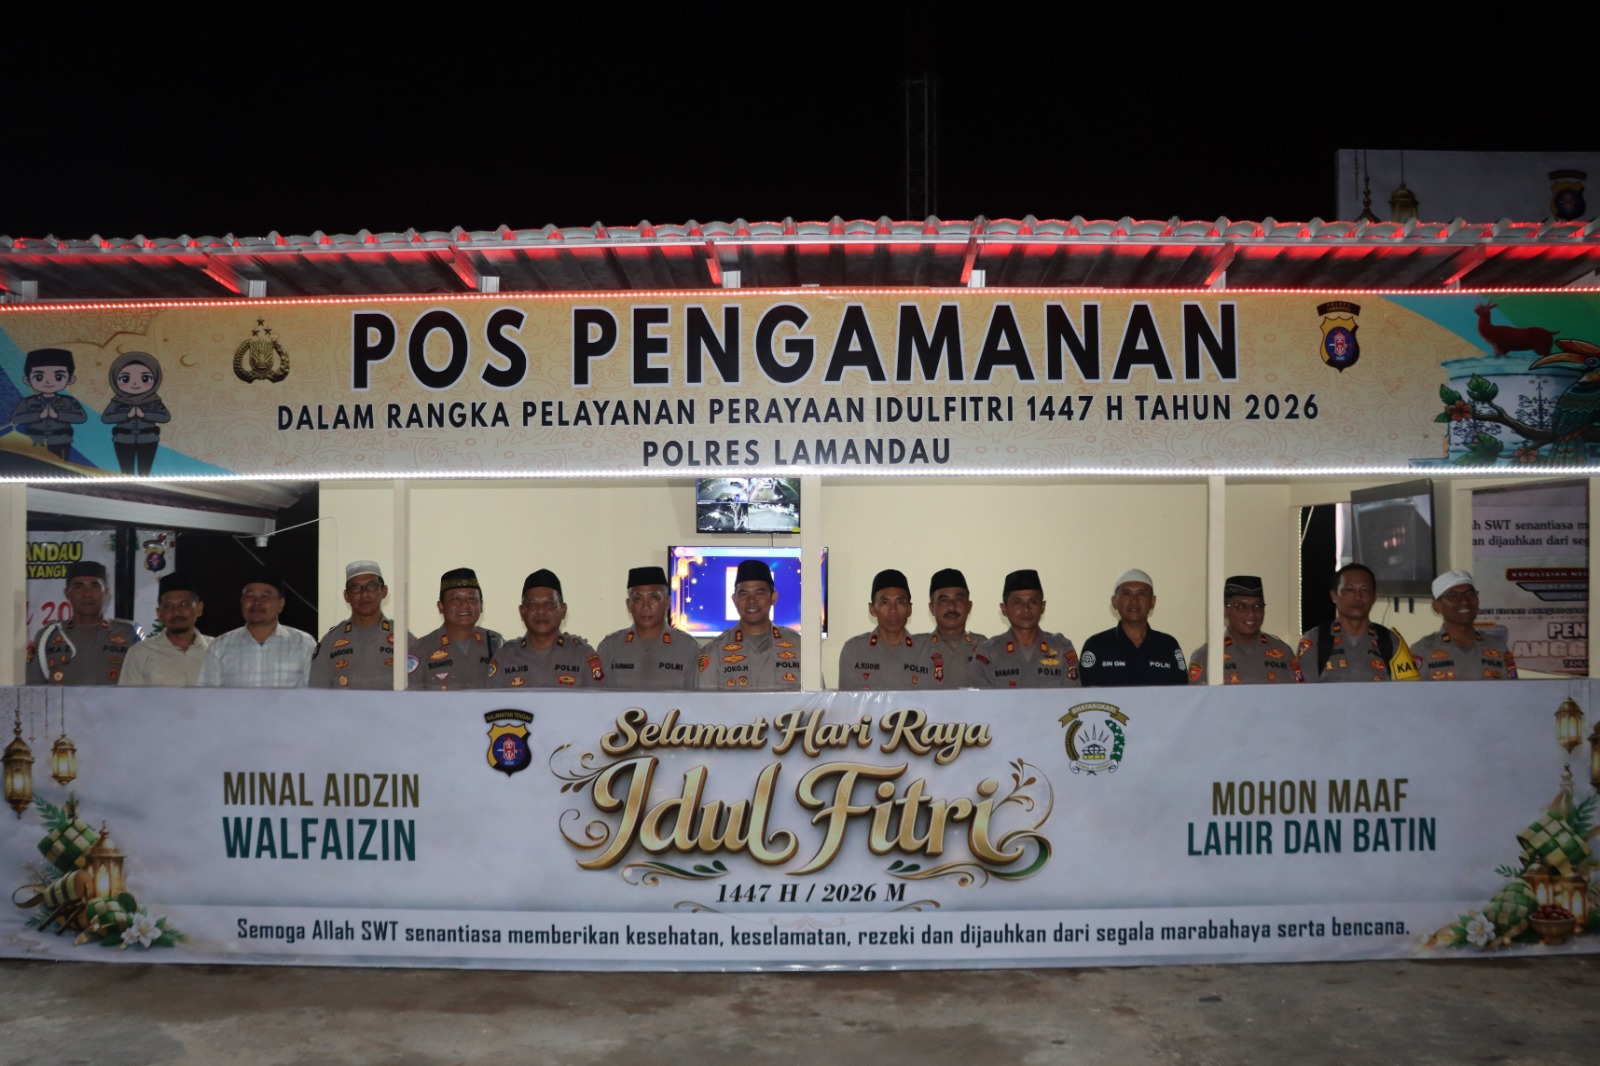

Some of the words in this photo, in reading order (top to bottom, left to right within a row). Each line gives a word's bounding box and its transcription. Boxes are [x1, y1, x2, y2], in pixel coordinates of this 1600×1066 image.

[354, 309, 527, 388] POS
[574, 304, 1237, 385] PENGAMANAN
[278, 404, 374, 430] DALAM
[388, 402, 509, 428] RANGKA
[523, 399, 695, 426] PELAYANAN
[710, 397, 865, 424] PERAYAAN
[876, 396, 1013, 422] IDULFITRI
[1027, 396, 1093, 421] 1447
[1107, 396, 1122, 420] H
[1135, 395, 1231, 420] TAHUN
[1245, 394, 1319, 419] 2026
[643, 440, 760, 466] POLRES
[775, 438, 950, 465] LAMANDAU
[1485, 520, 1511, 530] SWT
[1515, 520, 1573, 530] senantiasa
[1488, 535, 1543, 547] dijauhkan
[1546, 535, 1569, 546] dari
[554, 663, 580, 673] POLRI
[658, 662, 684, 672] POLRI
[775, 661, 800, 669] POLRI
[903, 663, 929, 675] POLRI
[1037, 667, 1062, 677] POLRI
[1149, 661, 1171, 669] POLRI
[1263, 660, 1288, 670] POLRI
[1071, 703, 1117, 715] BHAYANGKARI
[600, 707, 767, 756] Selamat
[773, 709, 872, 757] Hari
[879, 708, 993, 765] Raya
[224, 772, 314, 806] MINAL
[323, 773, 420, 808] AIDZIN
[1213, 780, 1317, 816] MOHON
[1326, 778, 1409, 813] MAAF
[575, 755, 799, 871] Idul
[785, 761, 1025, 877] Fitri
[222, 817, 417, 861] WALFAIZIN
[1188, 821, 1273, 856] LAHIR
[1285, 819, 1342, 854] DAN
[1354, 817, 1436, 852] BATIN
[716, 883, 772, 903] 1447
[778, 883, 799, 903] H
[822, 883, 877, 903] 2026
[885, 883, 907, 903] M
[238, 918, 305, 943] Semoga
[312, 919, 355, 941] Allah
[362, 921, 399, 942] SWT
[405, 925, 501, 944] senantiasa
[508, 924, 619, 946] memberikan
[626, 925, 724, 948] kesehatan,
[731, 925, 852, 948] keselamatan,
[859, 924, 914, 946] rezeki
[922, 924, 954, 945] dan
[960, 923, 1047, 949] dijauhkan
[1053, 922, 1090, 943] dari
[1097, 921, 1155, 947] segala
[1161, 919, 1271, 943] marabahaya
[1278, 920, 1326, 939] serta
[1332, 917, 1410, 937] bencana.
